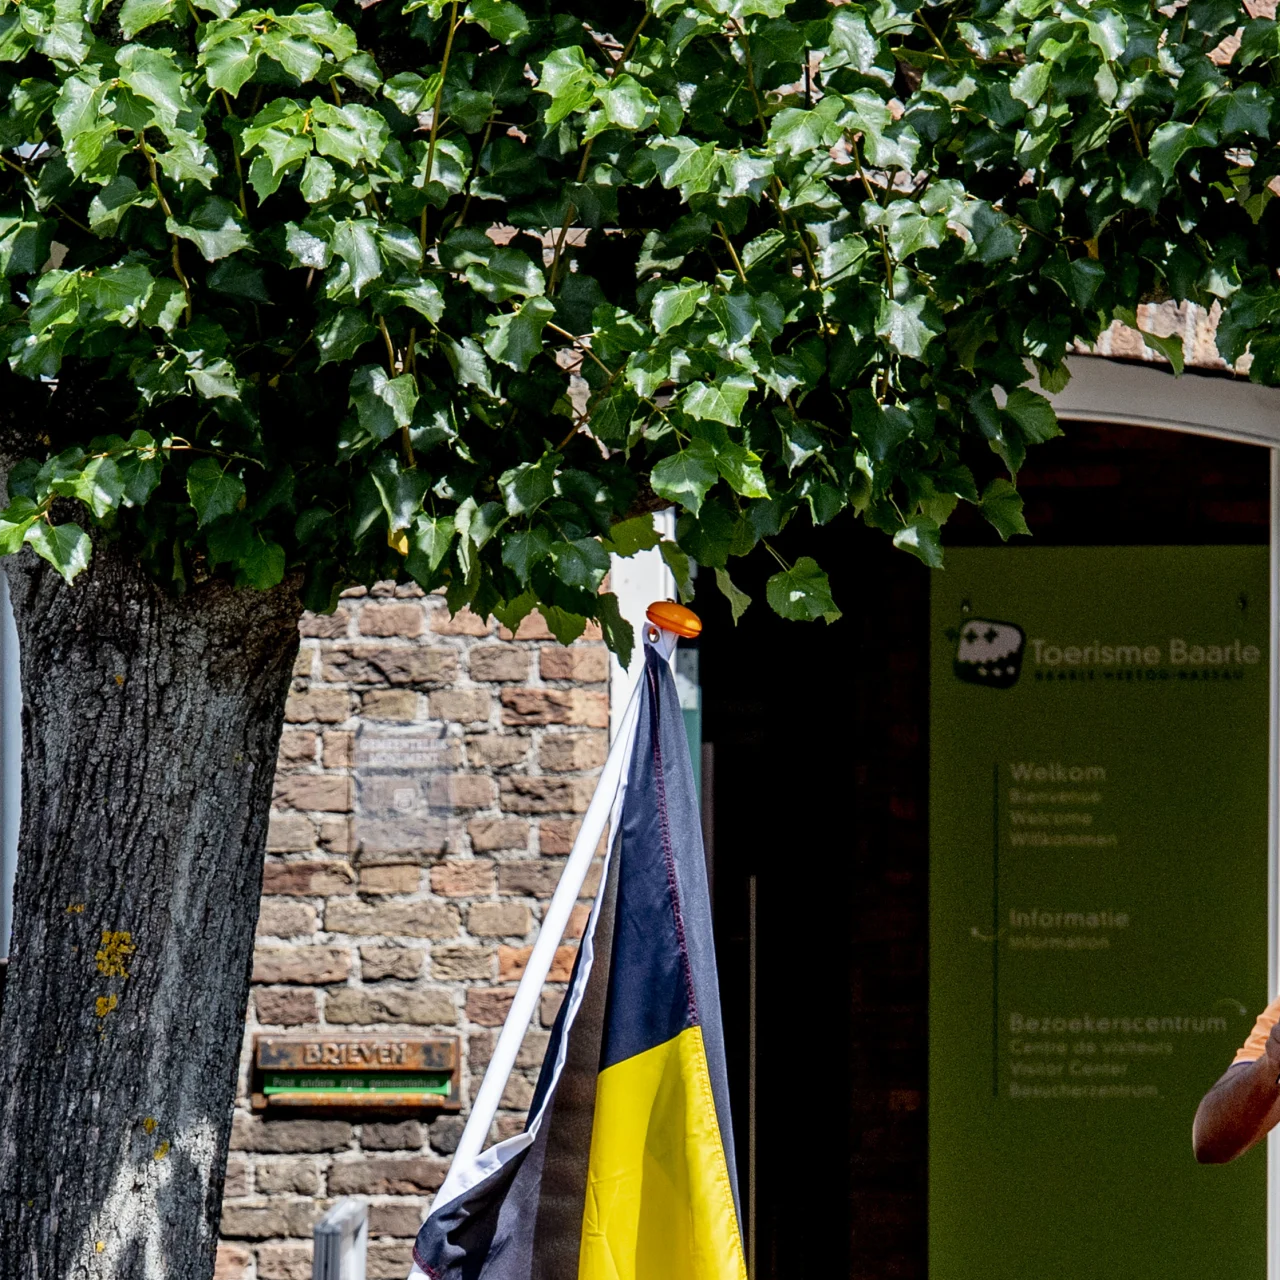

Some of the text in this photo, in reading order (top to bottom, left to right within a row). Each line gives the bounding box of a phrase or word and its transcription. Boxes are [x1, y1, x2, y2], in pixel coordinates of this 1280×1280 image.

[1033, 638, 1261, 666] Toerisme Baarle
[1009, 762, 1107, 782] Welkom
[1009, 908, 1129, 928] Informatie
[1009, 1012, 1228, 1033] Bezoekerscentrum
[304, 1043, 407, 1065] BRIEVEN
